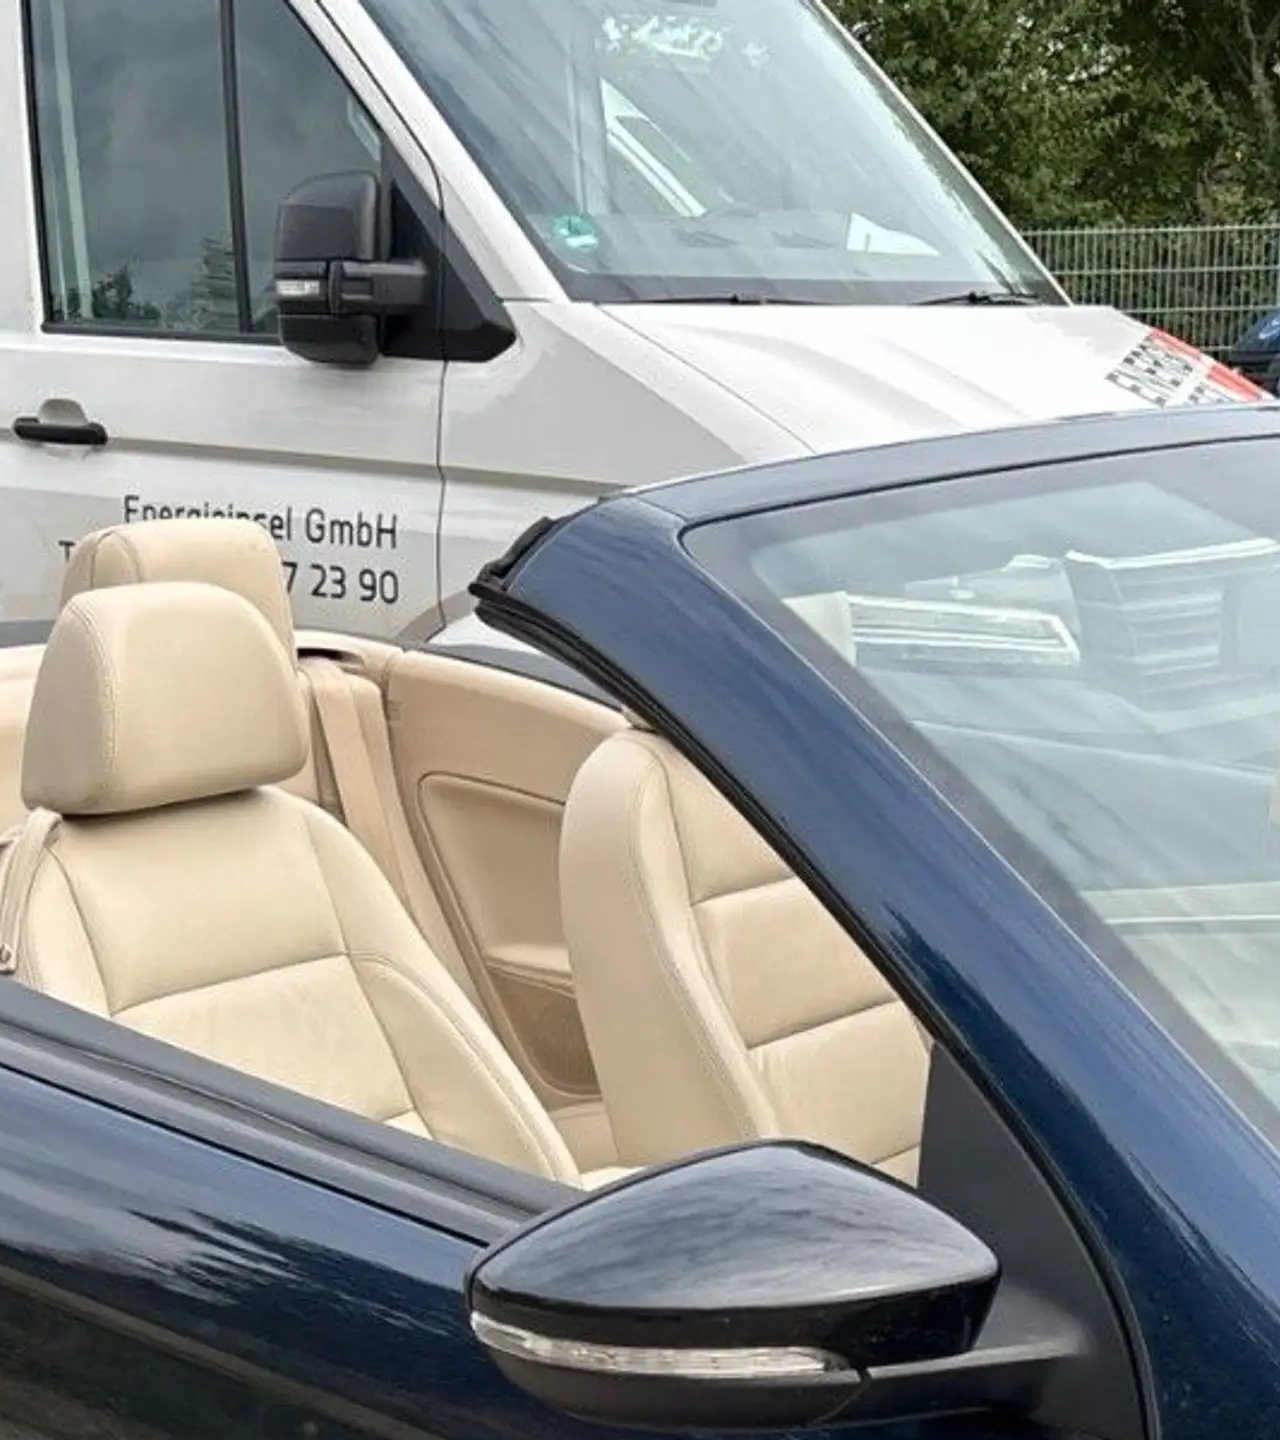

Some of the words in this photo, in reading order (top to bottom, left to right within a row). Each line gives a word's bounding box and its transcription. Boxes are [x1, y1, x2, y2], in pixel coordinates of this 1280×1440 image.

[304, 507, 399, 550] GmbH
[310, 563, 348, 600] 23
[358, 568, 401, 605] 90
